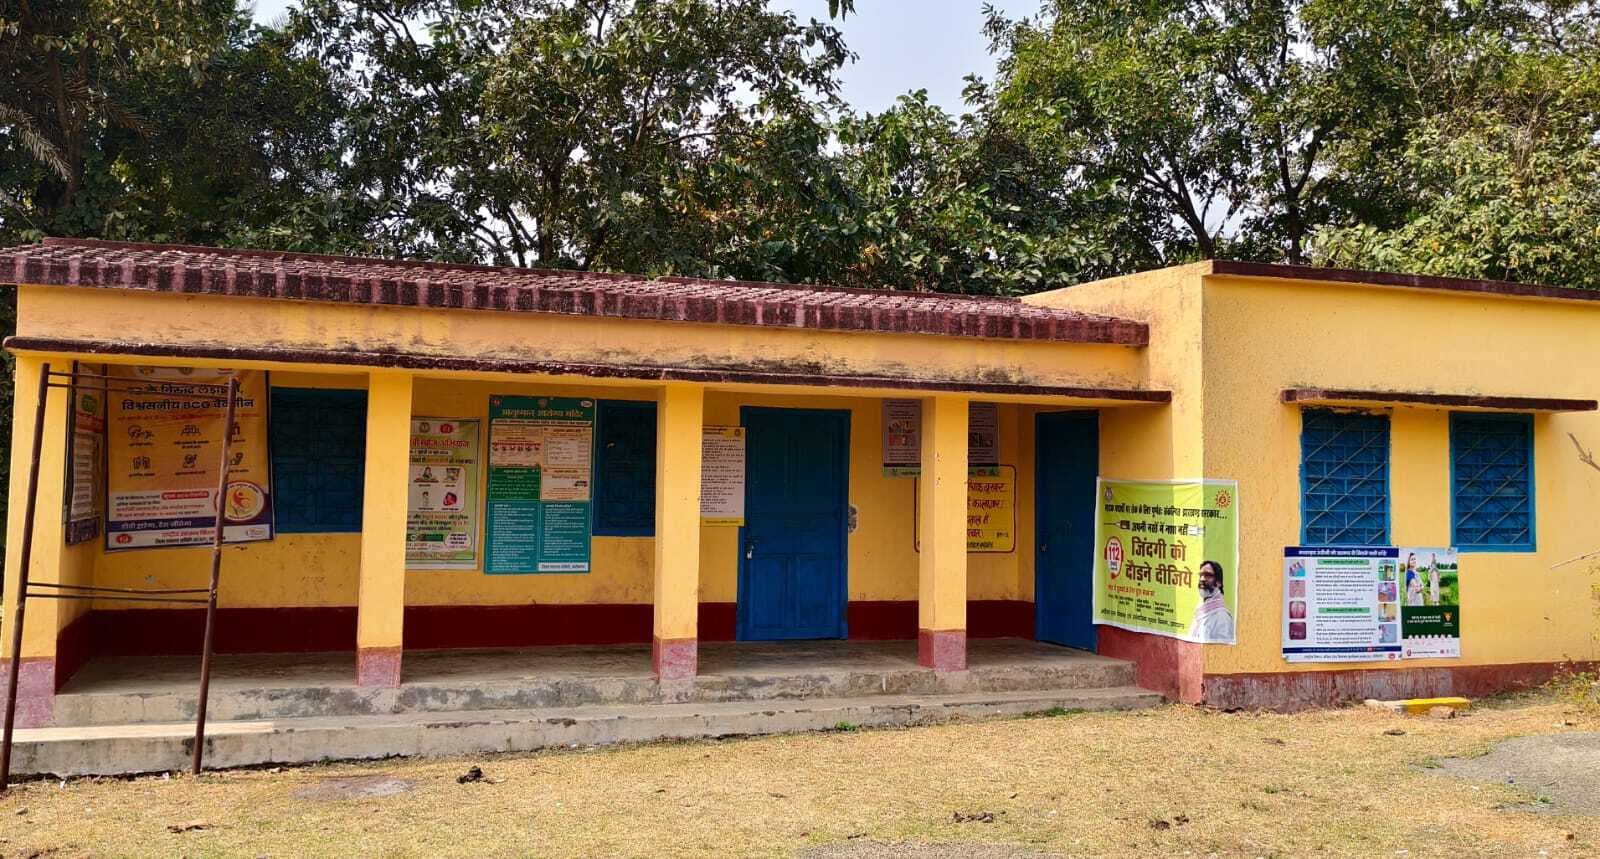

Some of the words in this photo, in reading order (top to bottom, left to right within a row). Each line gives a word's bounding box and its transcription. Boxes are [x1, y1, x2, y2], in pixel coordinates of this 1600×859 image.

[122, 399, 180, 411] विश्वसनीय
[183, 401, 210, 410] BCG
[1109, 546, 1120, 560] 112
[1132, 536, 1167, 559] जिंदगी
[1170, 540, 1187, 561] को
[1125, 560, 1153, 587] दौड़ने
[1155, 563, 1193, 588] दीजिये
